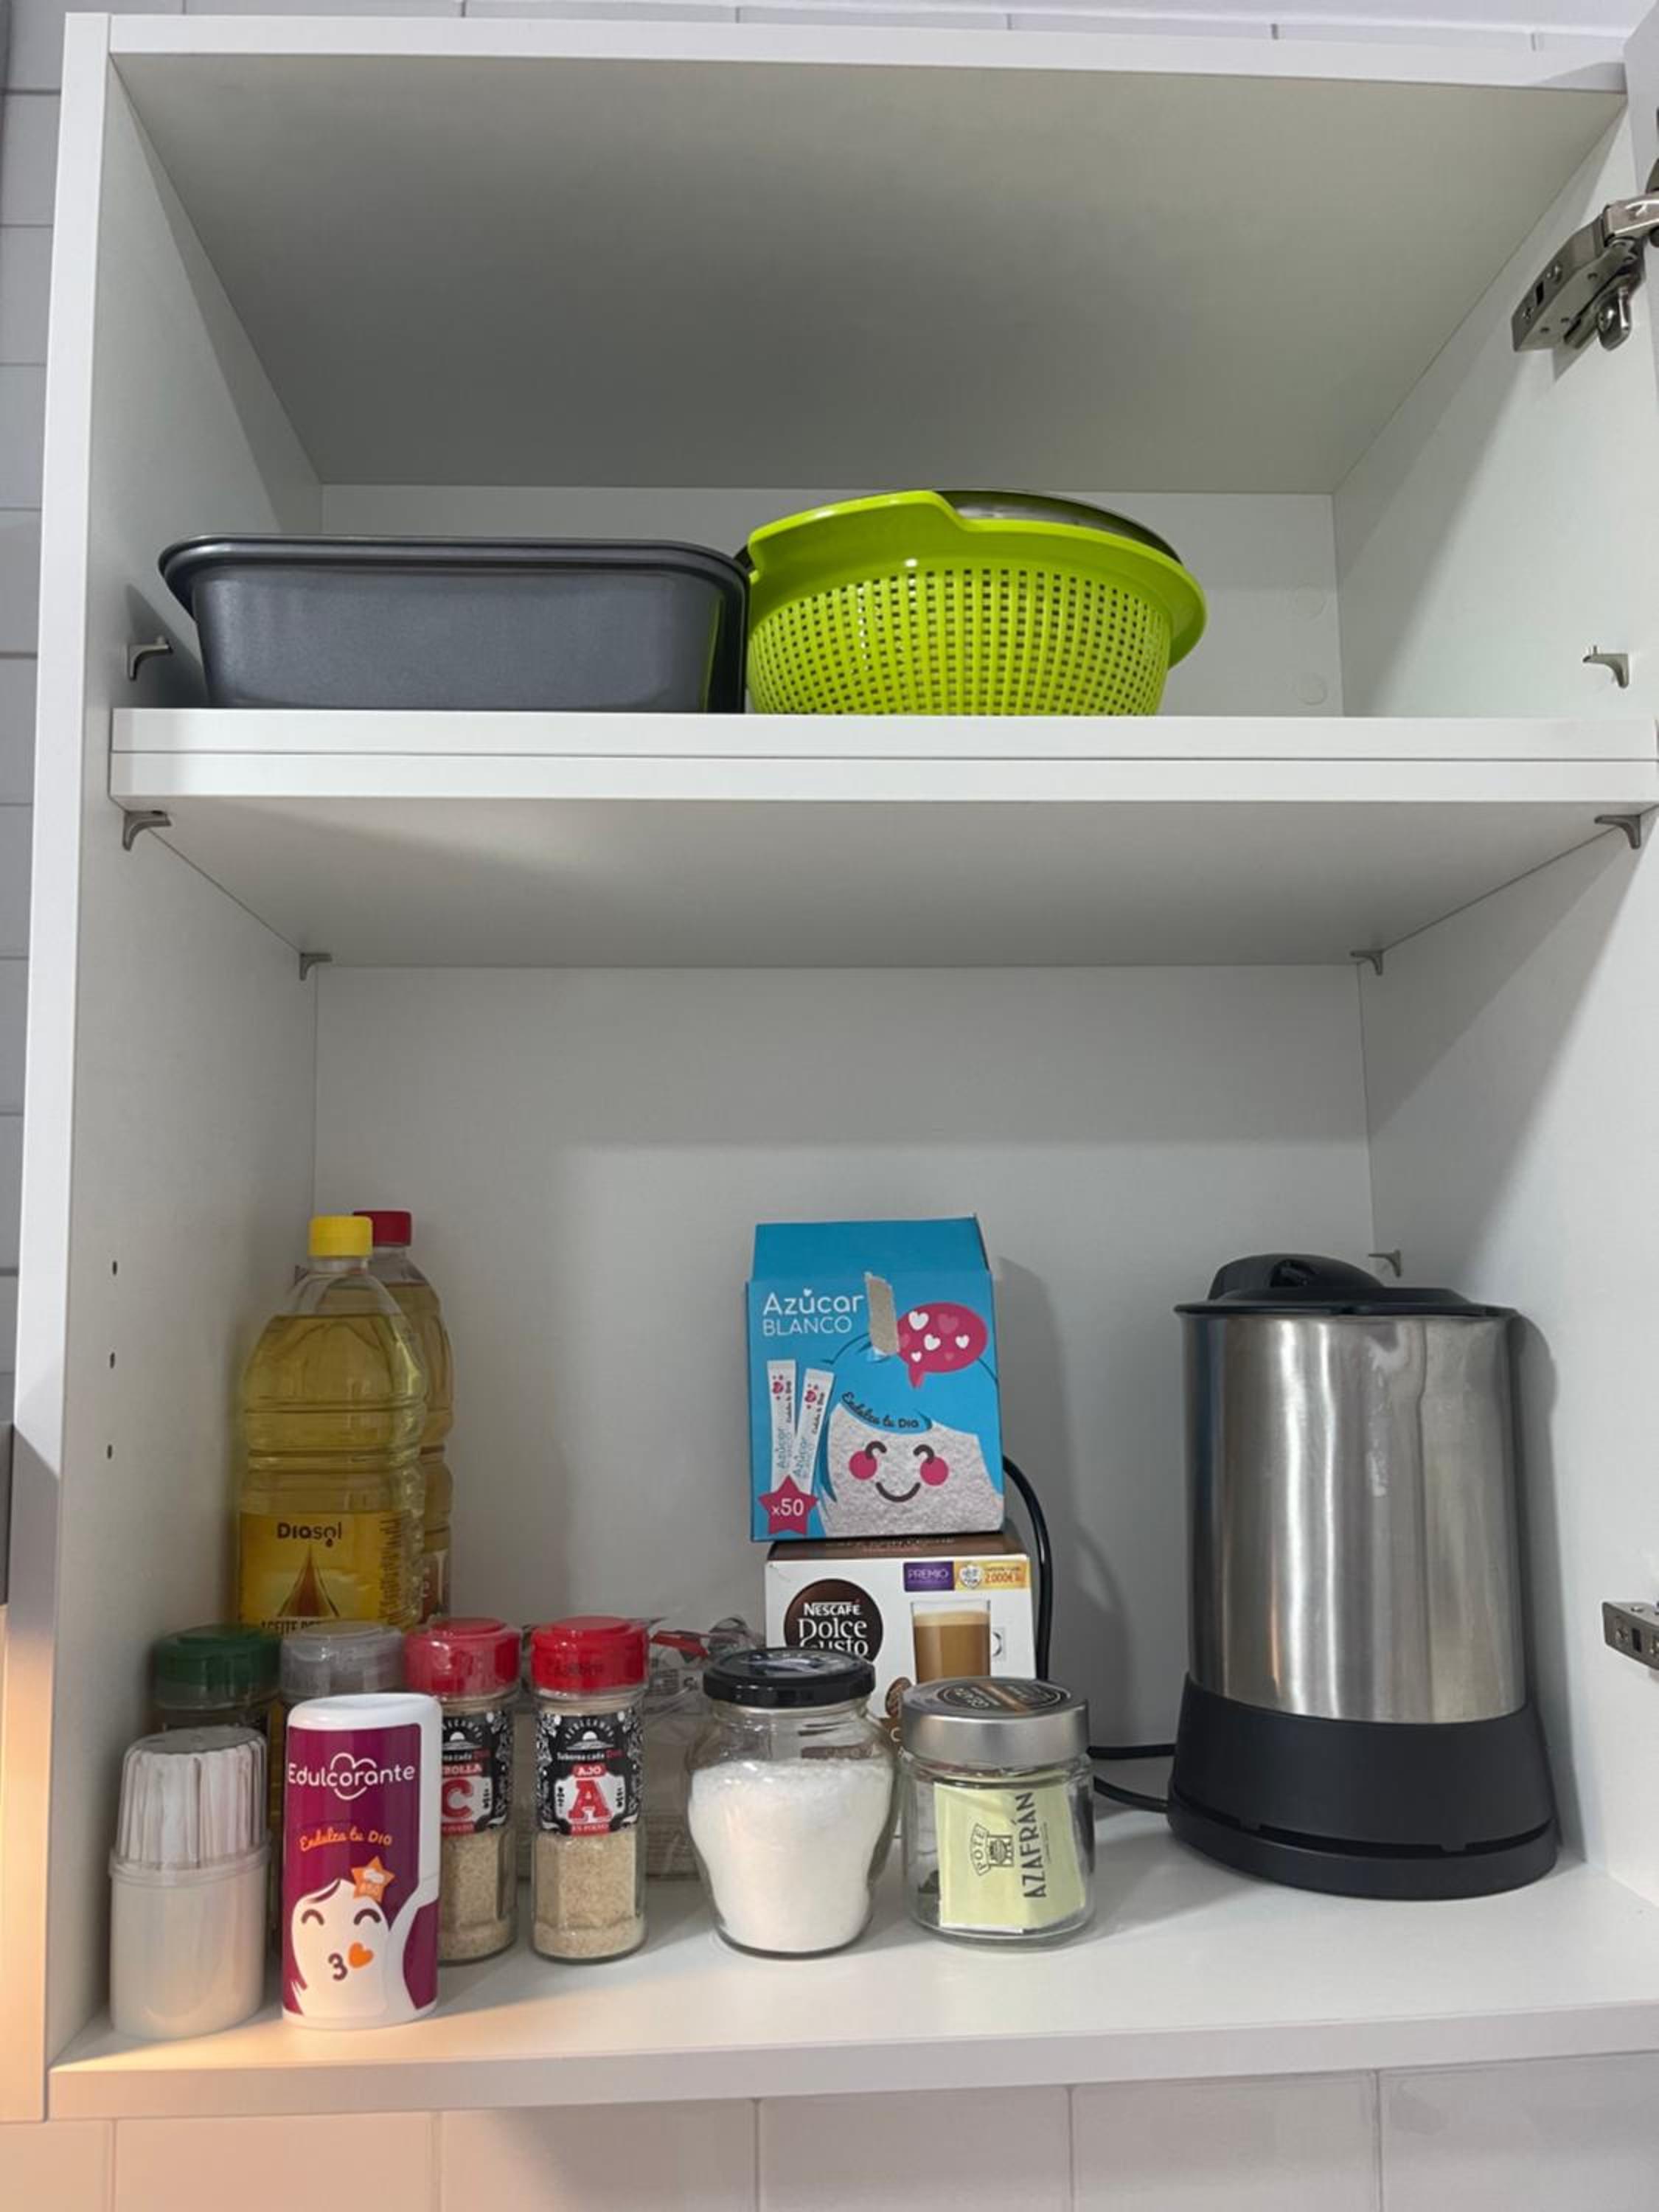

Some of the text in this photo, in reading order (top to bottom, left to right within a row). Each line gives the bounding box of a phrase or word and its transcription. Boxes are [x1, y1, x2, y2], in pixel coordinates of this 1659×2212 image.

[762, 1288, 865, 1316] Azúcar
[763, 1315, 852, 1336] BLANCO
[773, 1498, 805, 1517] x50
[799, 1617, 868, 1640] Dolce
[288, 1762, 416, 1787] Edulcorante
[443, 1762, 482, 1775] BOLLA
[577, 1765, 603, 1775] AJO
[442, 1778, 473, 1818] C
[567, 1779, 612, 1819] A
[1010, 1792, 1047, 1899] AZAFRÁN
